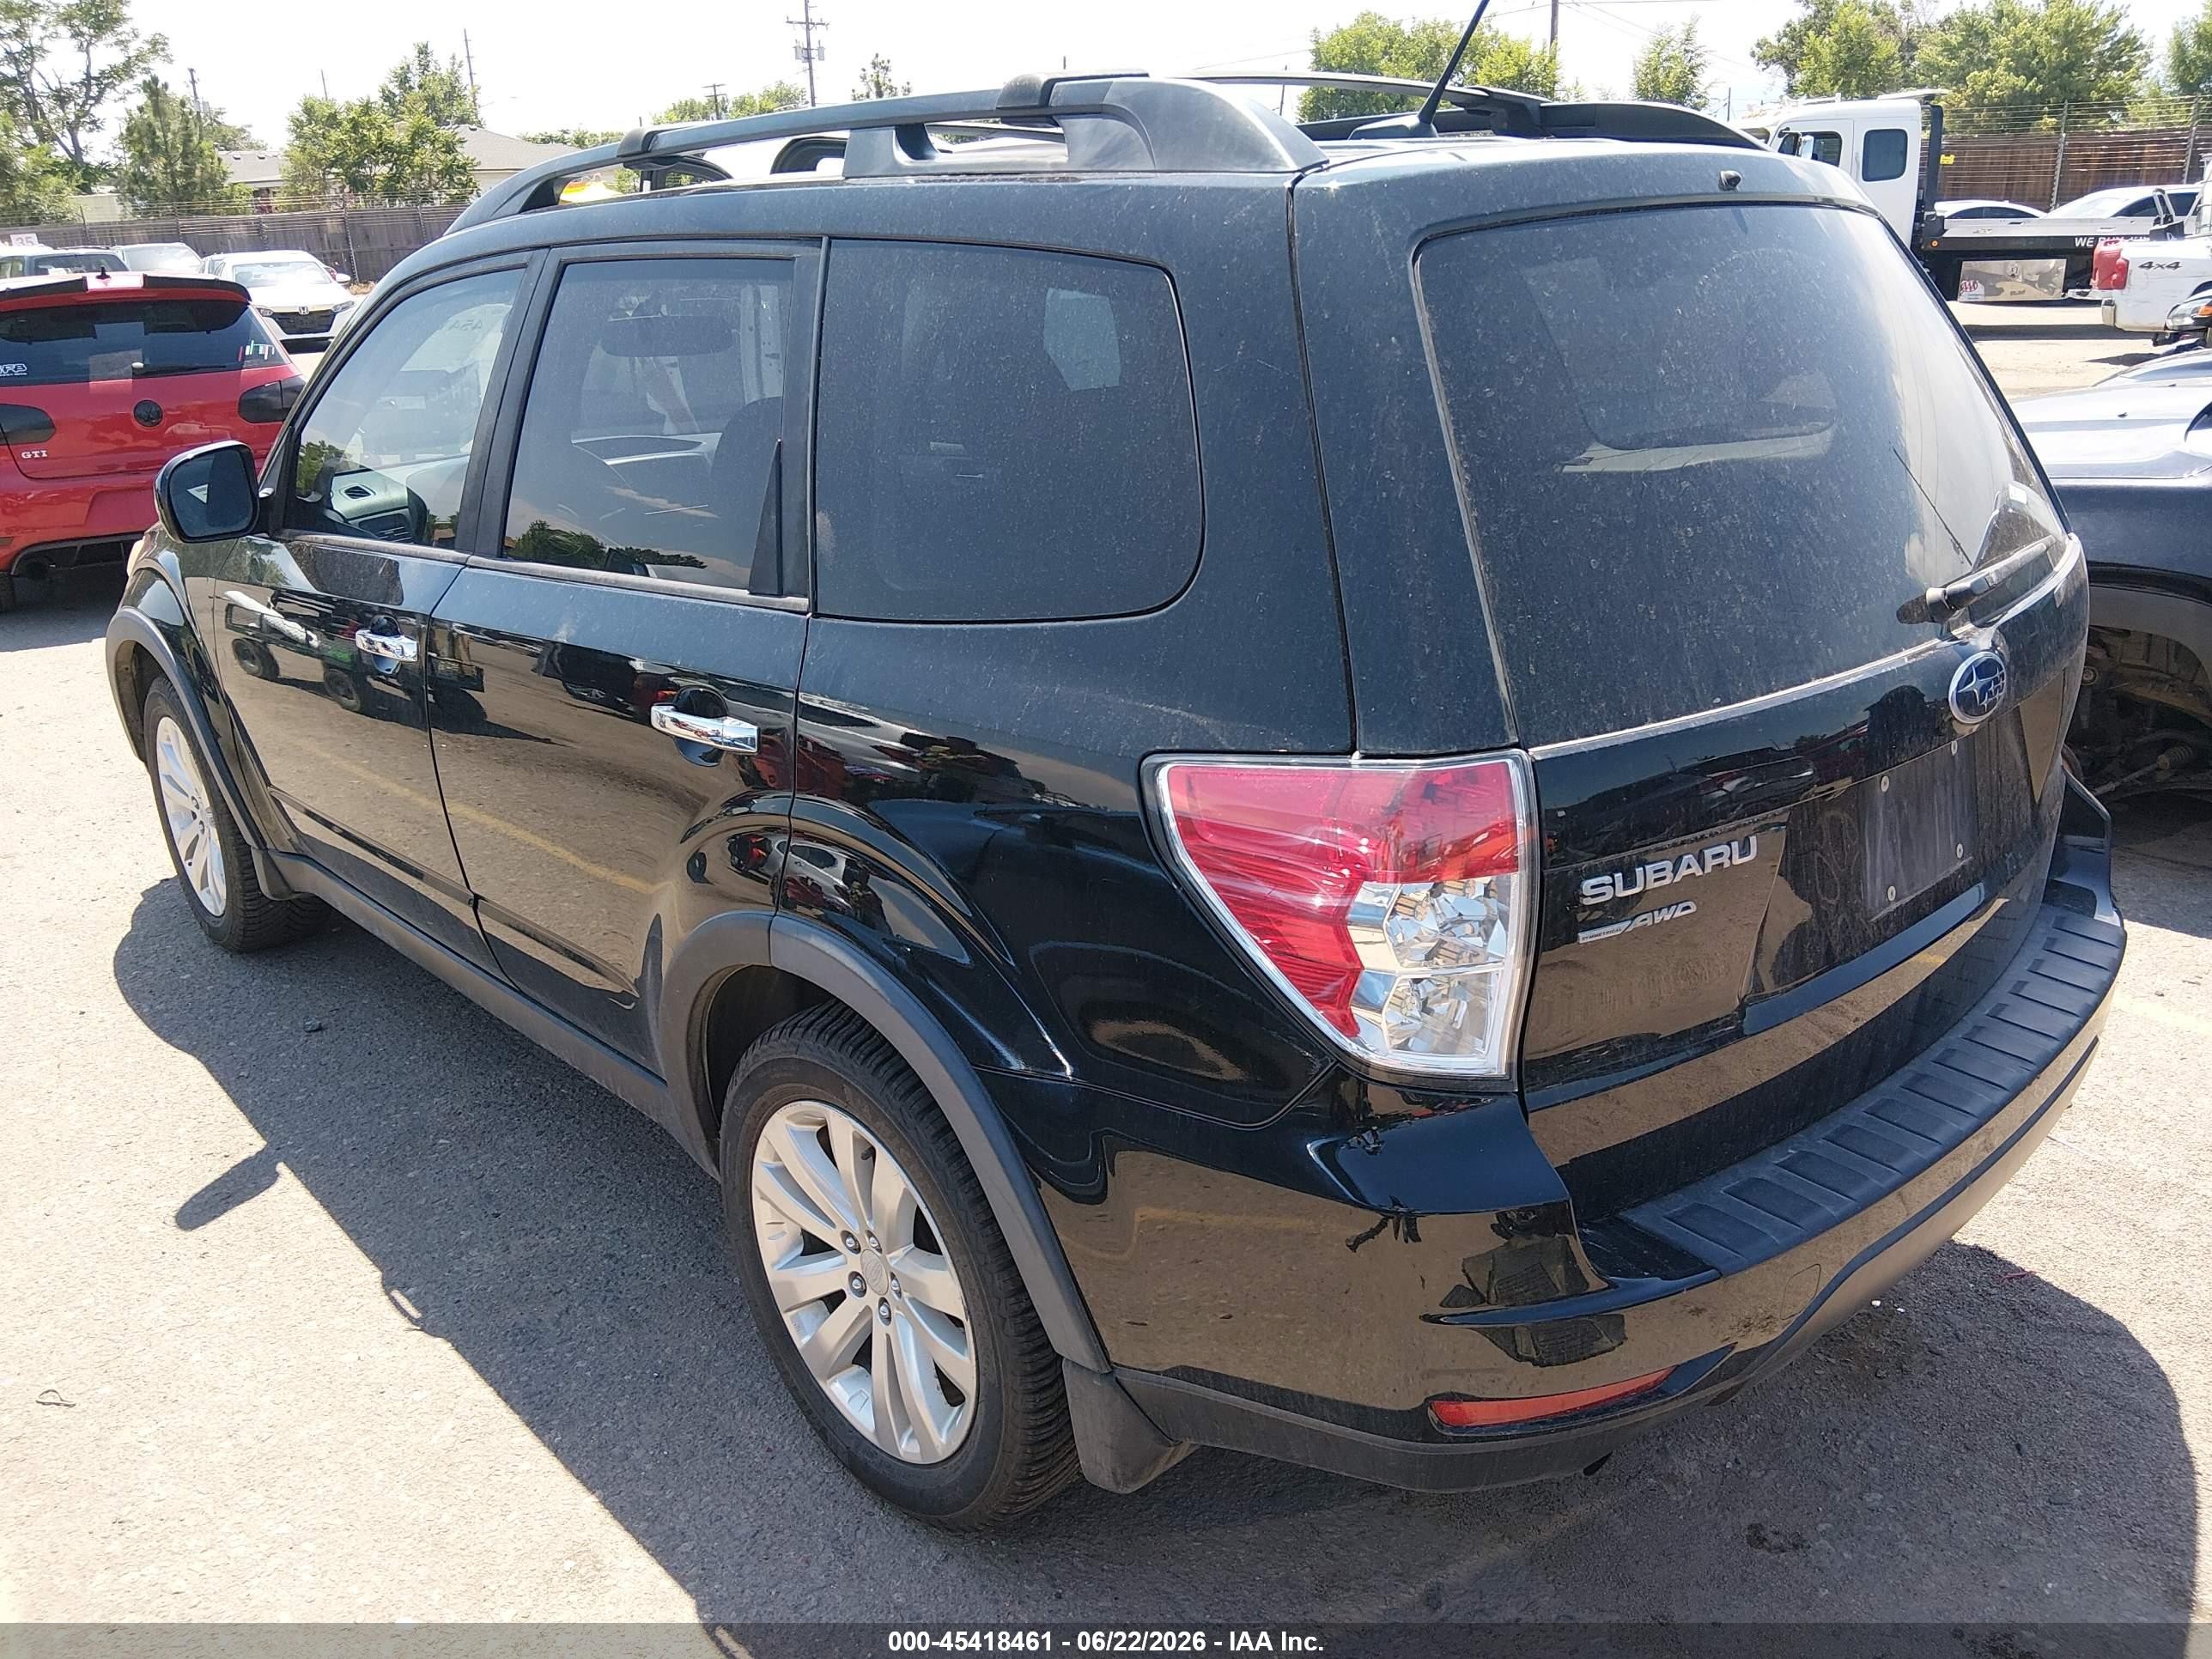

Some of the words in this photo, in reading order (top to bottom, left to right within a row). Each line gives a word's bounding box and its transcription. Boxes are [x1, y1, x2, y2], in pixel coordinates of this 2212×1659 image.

[2075, 237, 2094, 247] WE
[21, 450, 48, 459] GTI
[1580, 835, 1758, 906] SUBARU
[1625, 901, 1698, 933] AWD
